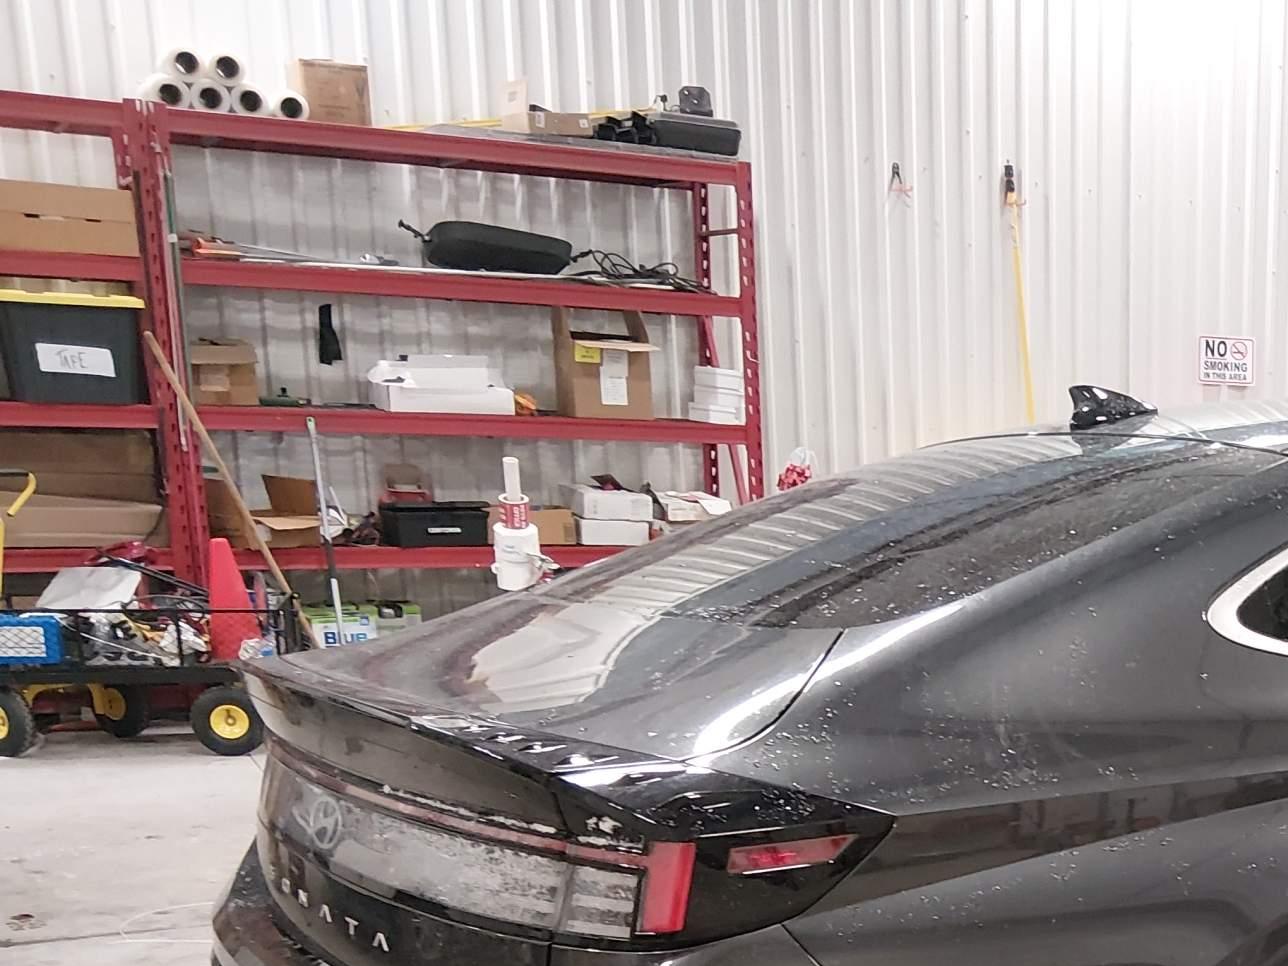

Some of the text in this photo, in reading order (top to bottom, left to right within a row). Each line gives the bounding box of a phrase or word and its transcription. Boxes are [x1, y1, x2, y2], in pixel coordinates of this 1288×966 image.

[1204, 339, 1228, 358] NO
[1203, 360, 1248, 373] SMOKING
[1212, 372, 1227, 380] THIS
[1228, 373, 1248, 381] AREA
